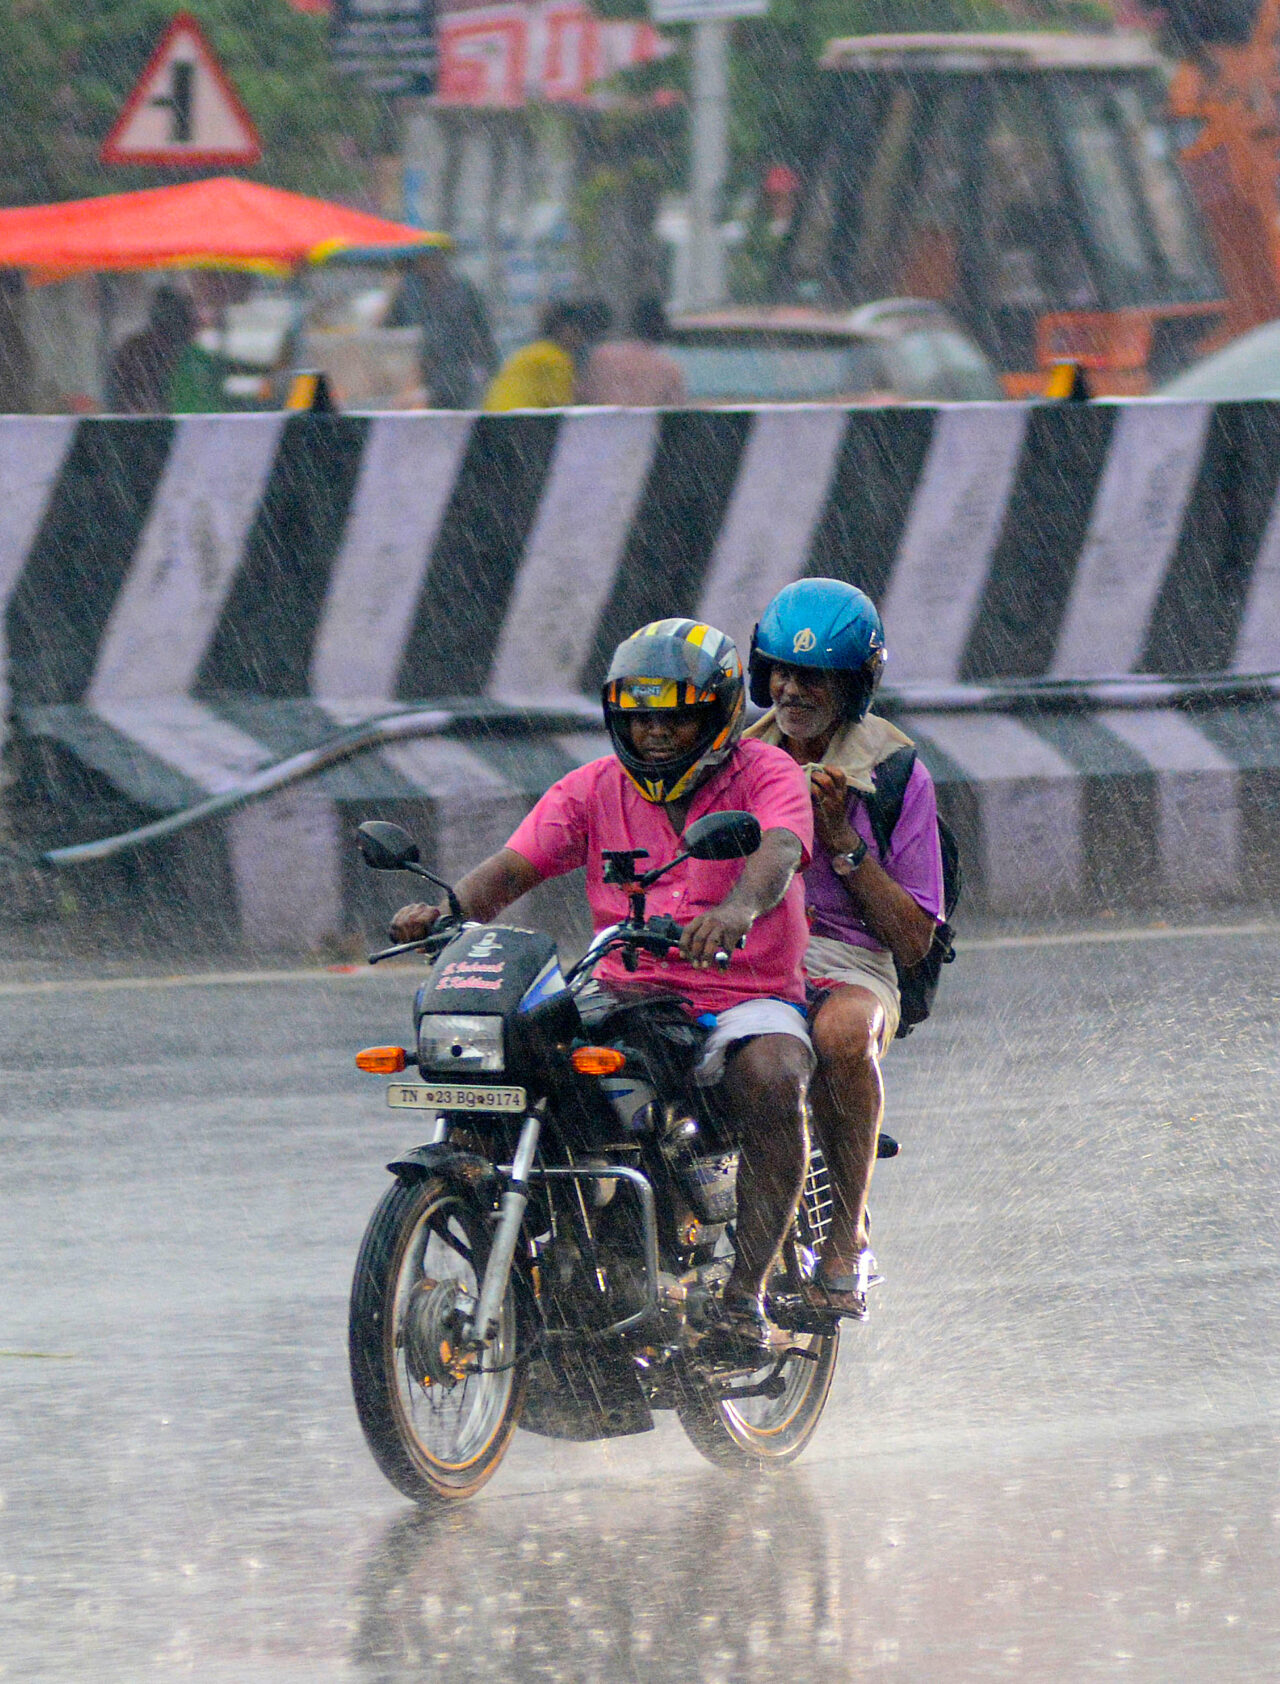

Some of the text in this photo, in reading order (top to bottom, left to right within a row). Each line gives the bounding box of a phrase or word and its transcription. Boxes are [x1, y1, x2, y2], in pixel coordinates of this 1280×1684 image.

[401, 1090, 417, 1102] TN
[435, 1091, 452, 1104] 23
[486, 1093, 520, 1106] 9174
